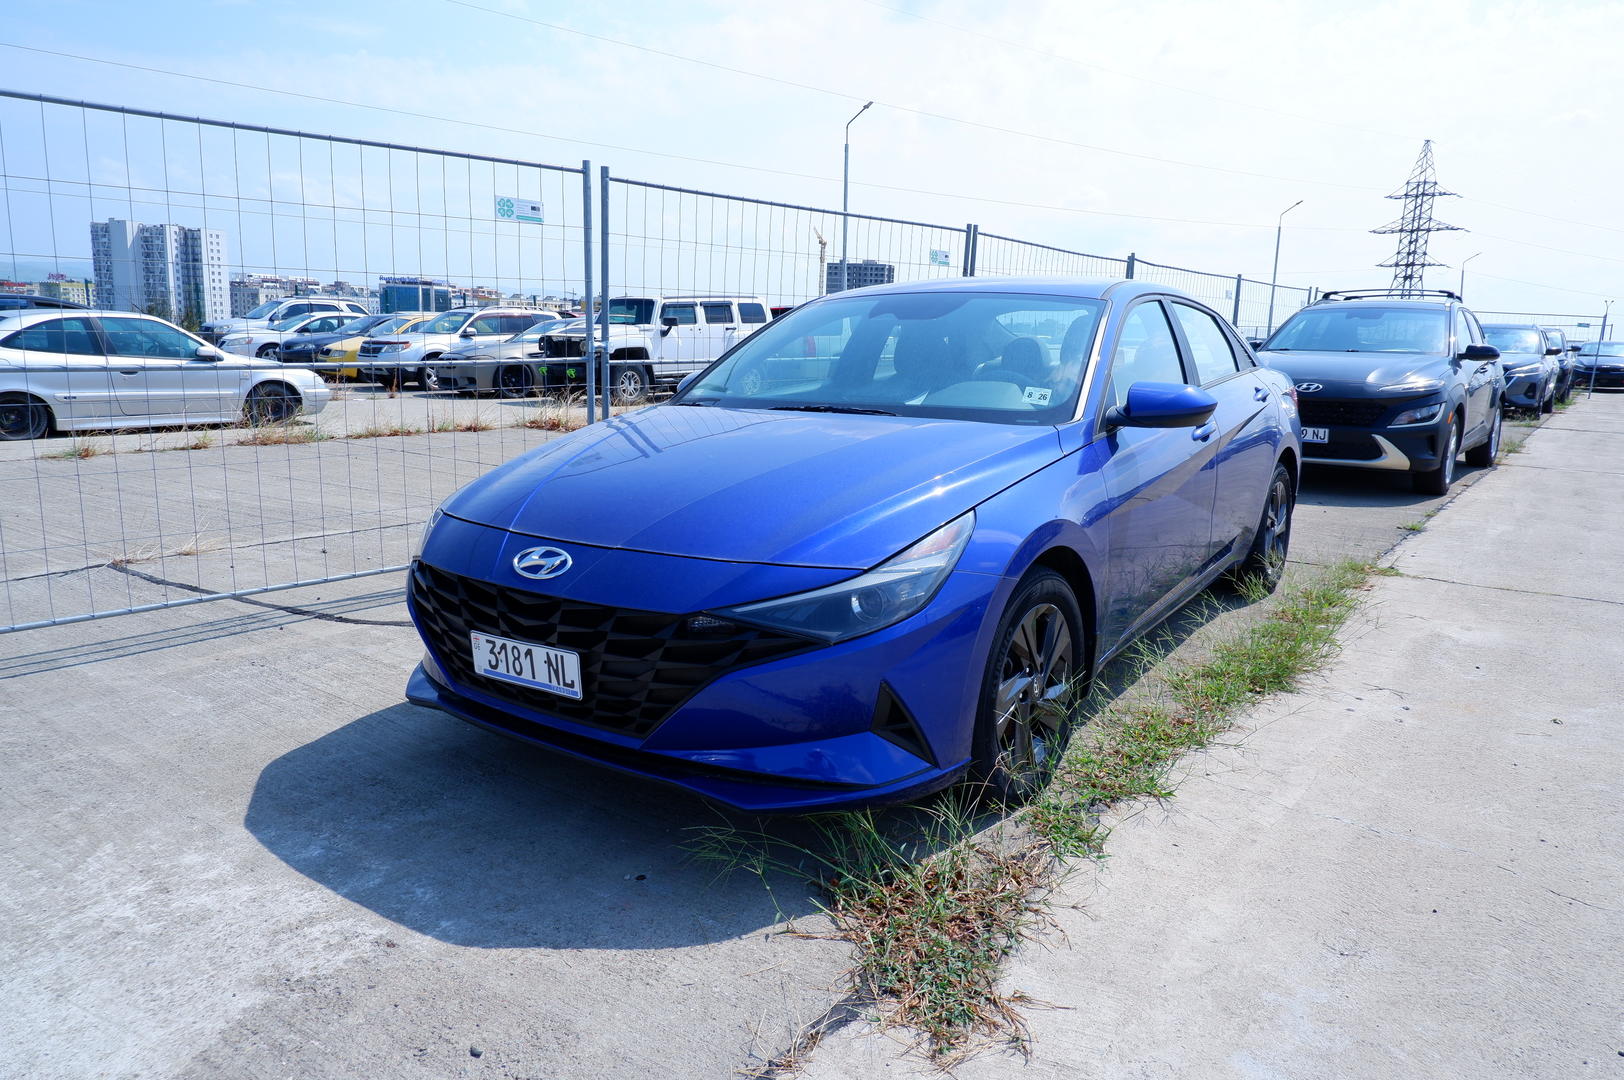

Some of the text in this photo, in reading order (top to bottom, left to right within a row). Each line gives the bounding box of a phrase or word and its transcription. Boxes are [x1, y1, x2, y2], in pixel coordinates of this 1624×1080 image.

[1027, 391, 1048, 401] 8 26
[1312, 429, 1327, 441] NJ
[485, 638, 575, 689] 3181 NL
